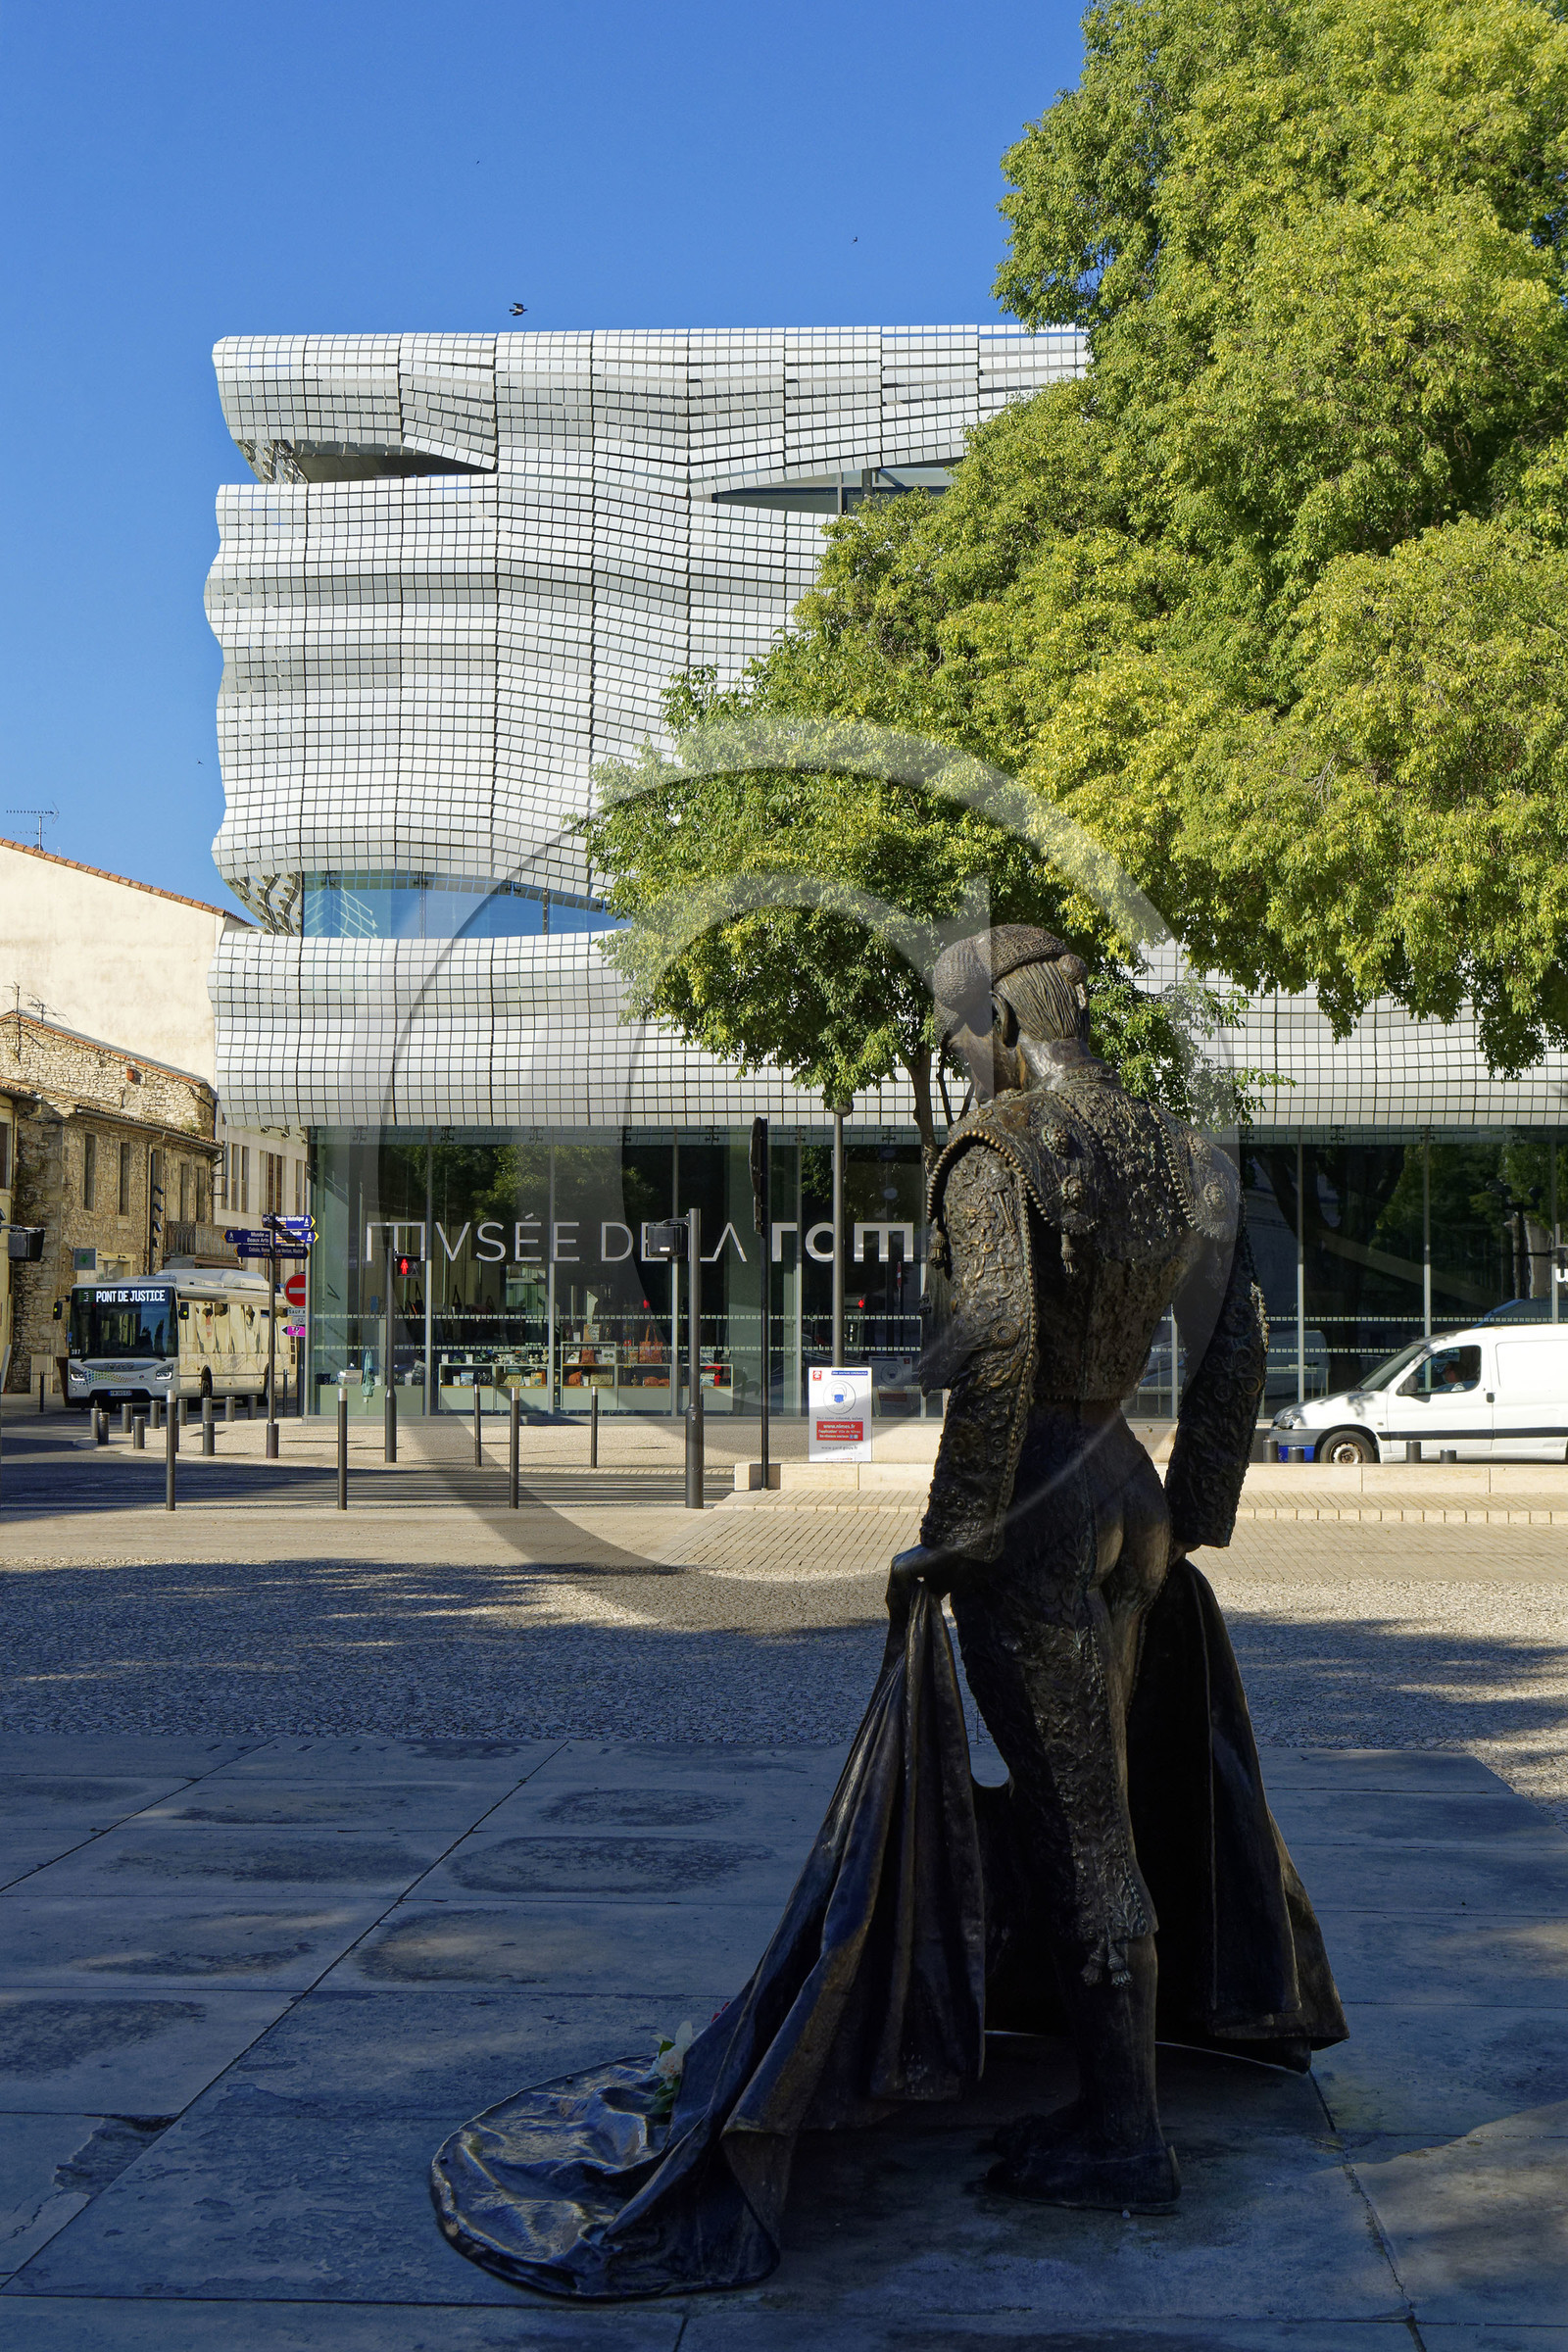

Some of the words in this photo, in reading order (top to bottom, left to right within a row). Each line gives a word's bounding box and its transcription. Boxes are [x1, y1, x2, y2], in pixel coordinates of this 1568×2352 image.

[96, 1291, 118, 1303] PONT
[118, 1291, 128, 1302] DE
[129, 1290, 166, 1302] JUSTICE
